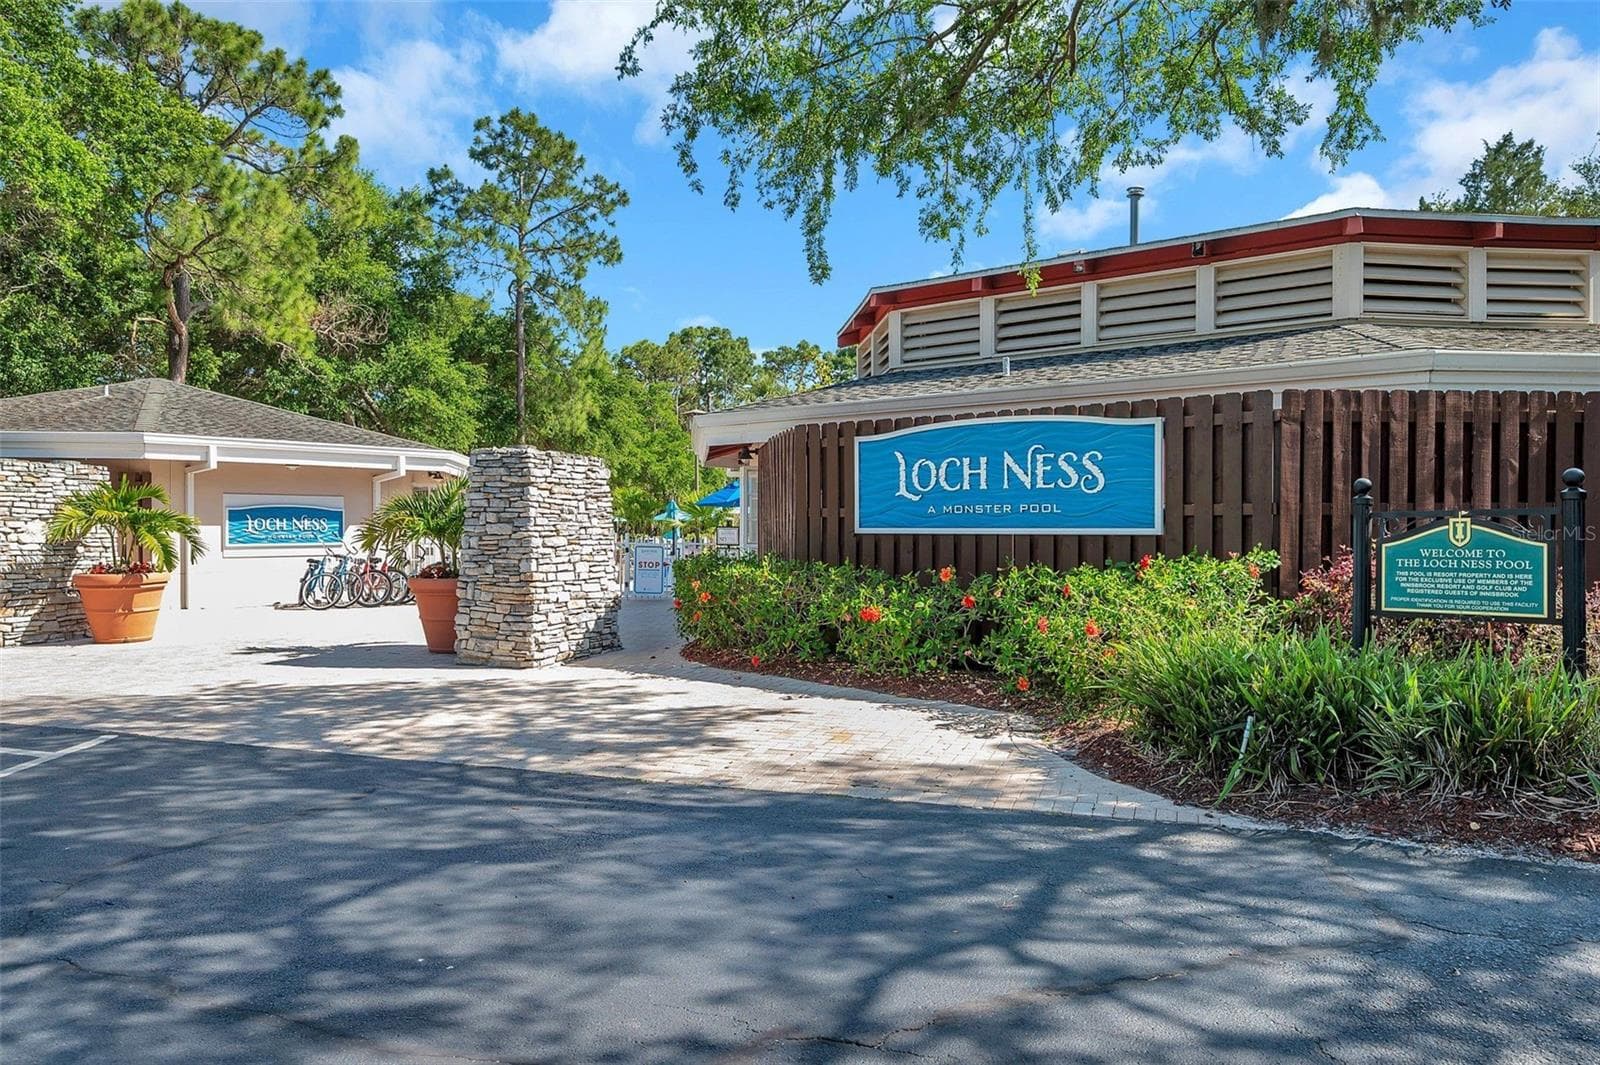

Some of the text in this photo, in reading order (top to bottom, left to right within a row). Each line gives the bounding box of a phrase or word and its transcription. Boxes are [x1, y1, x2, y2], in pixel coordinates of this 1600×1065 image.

[894, 445, 1105, 501] LOCH NESS
[927, 504, 1061, 514] A MONSTER POOL
[245, 514, 329, 535] LOCH NESS
[1420, 548, 1506, 558] WELCOME TO
[638, 561, 660, 569] STOP
[1396, 558, 1533, 570] THE LOCH NESS POOL
